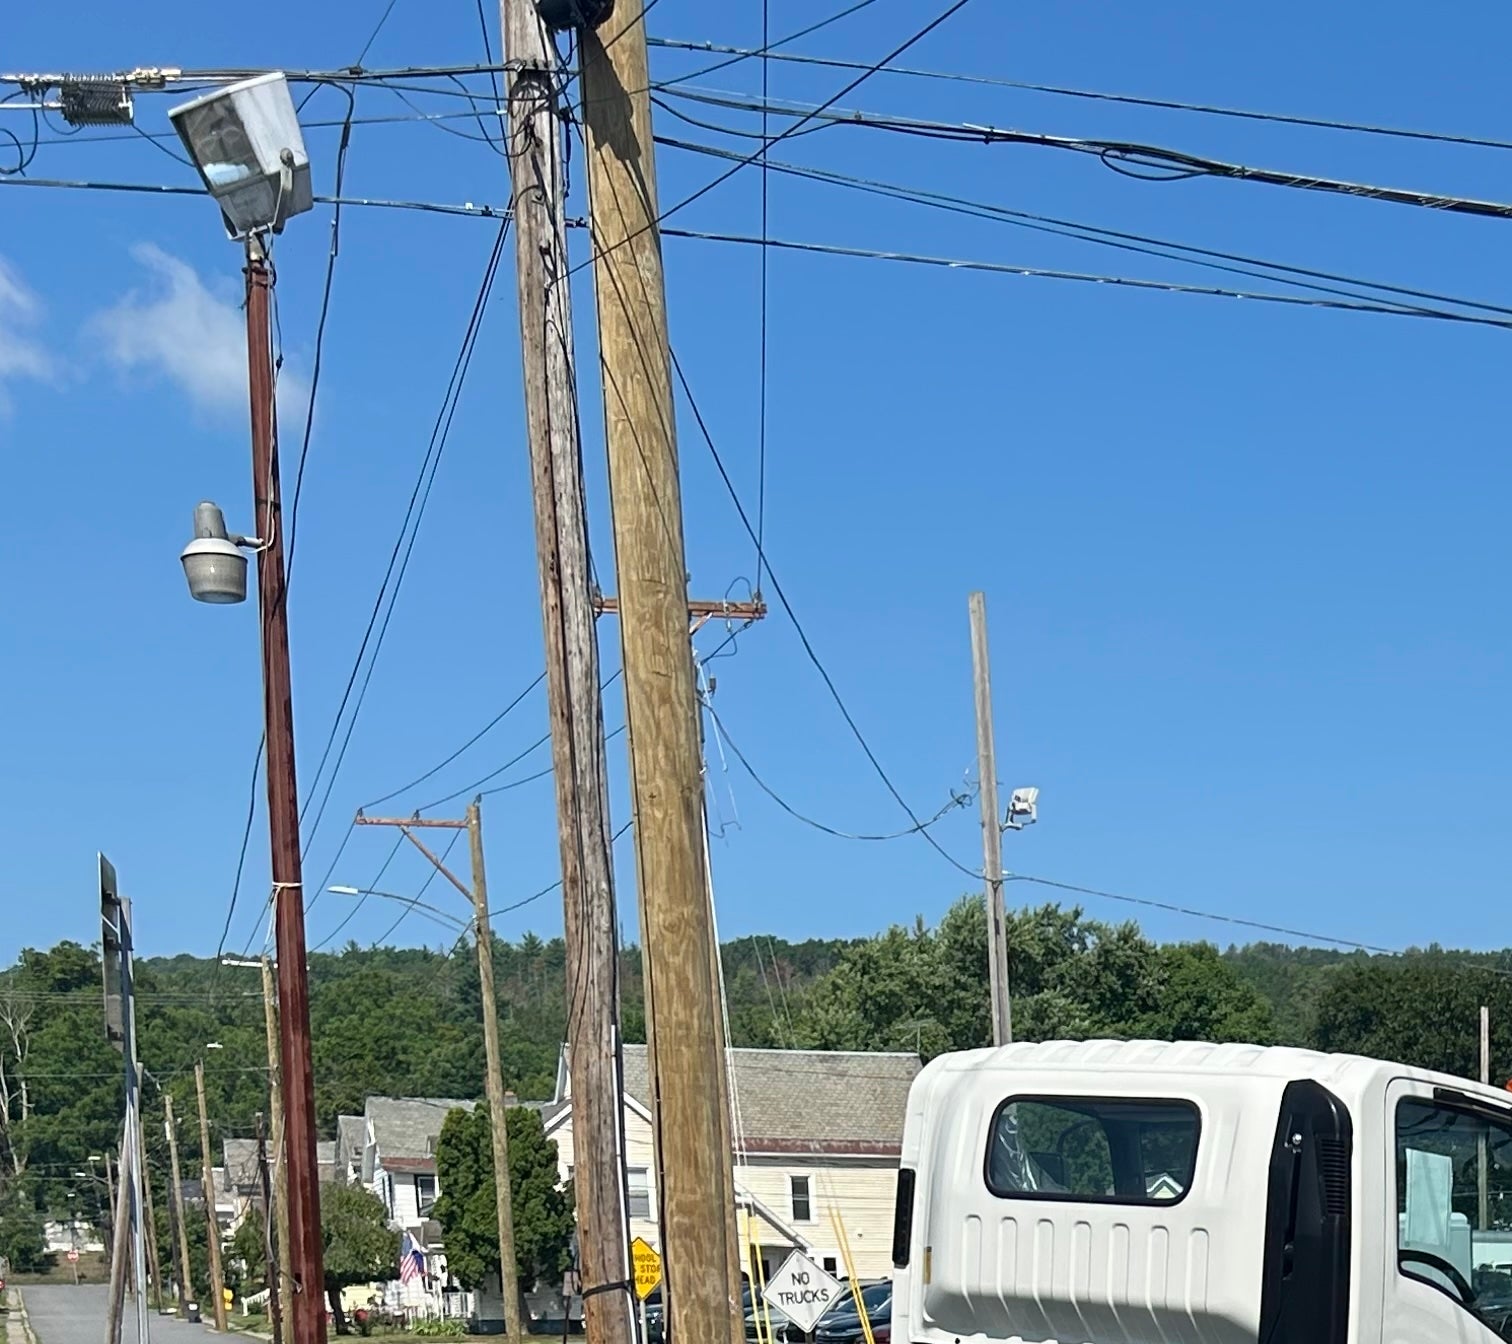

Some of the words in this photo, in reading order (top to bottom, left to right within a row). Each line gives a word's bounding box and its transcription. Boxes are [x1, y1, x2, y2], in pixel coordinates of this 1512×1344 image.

[634, 1254, 656, 1263] HOOL
[635, 1275, 656, 1285] HEAD
[791, 1272, 810, 1286] NO
[777, 1288, 830, 1306] TRUCKS
